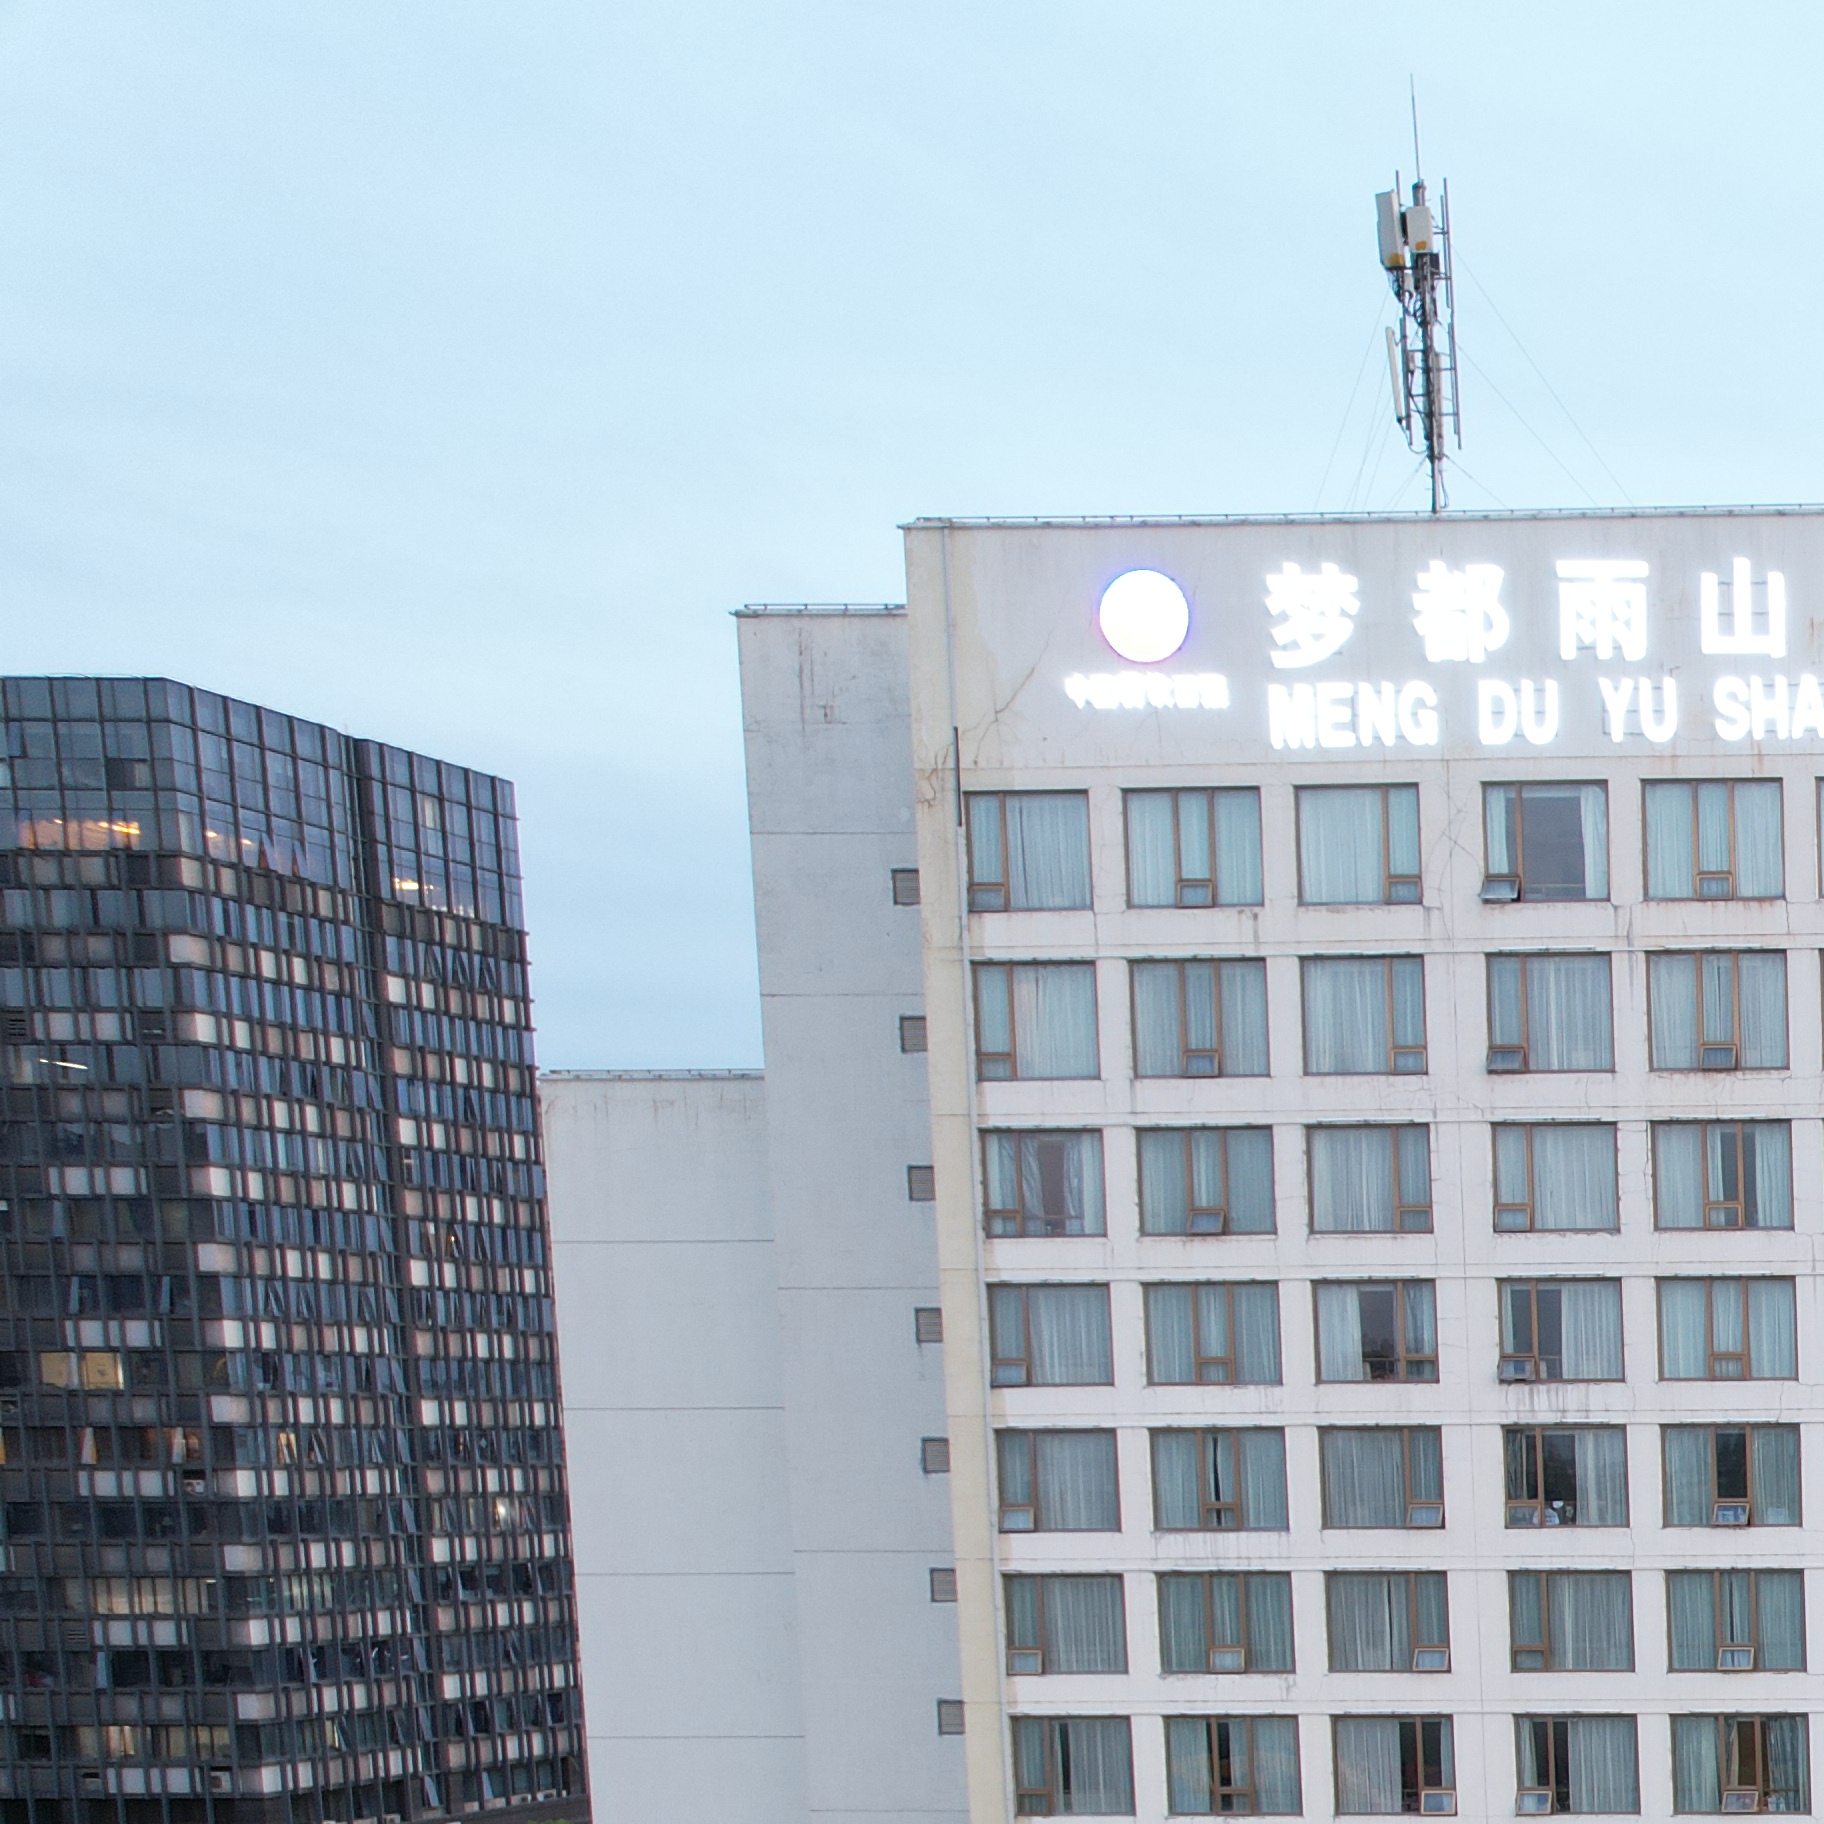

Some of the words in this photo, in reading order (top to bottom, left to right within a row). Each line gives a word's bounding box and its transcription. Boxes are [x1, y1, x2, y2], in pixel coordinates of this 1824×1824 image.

[1268, 680, 1440, 751] MENG
[1478, 678, 1560, 746] DU
[1599, 676, 1680, 744] YU
